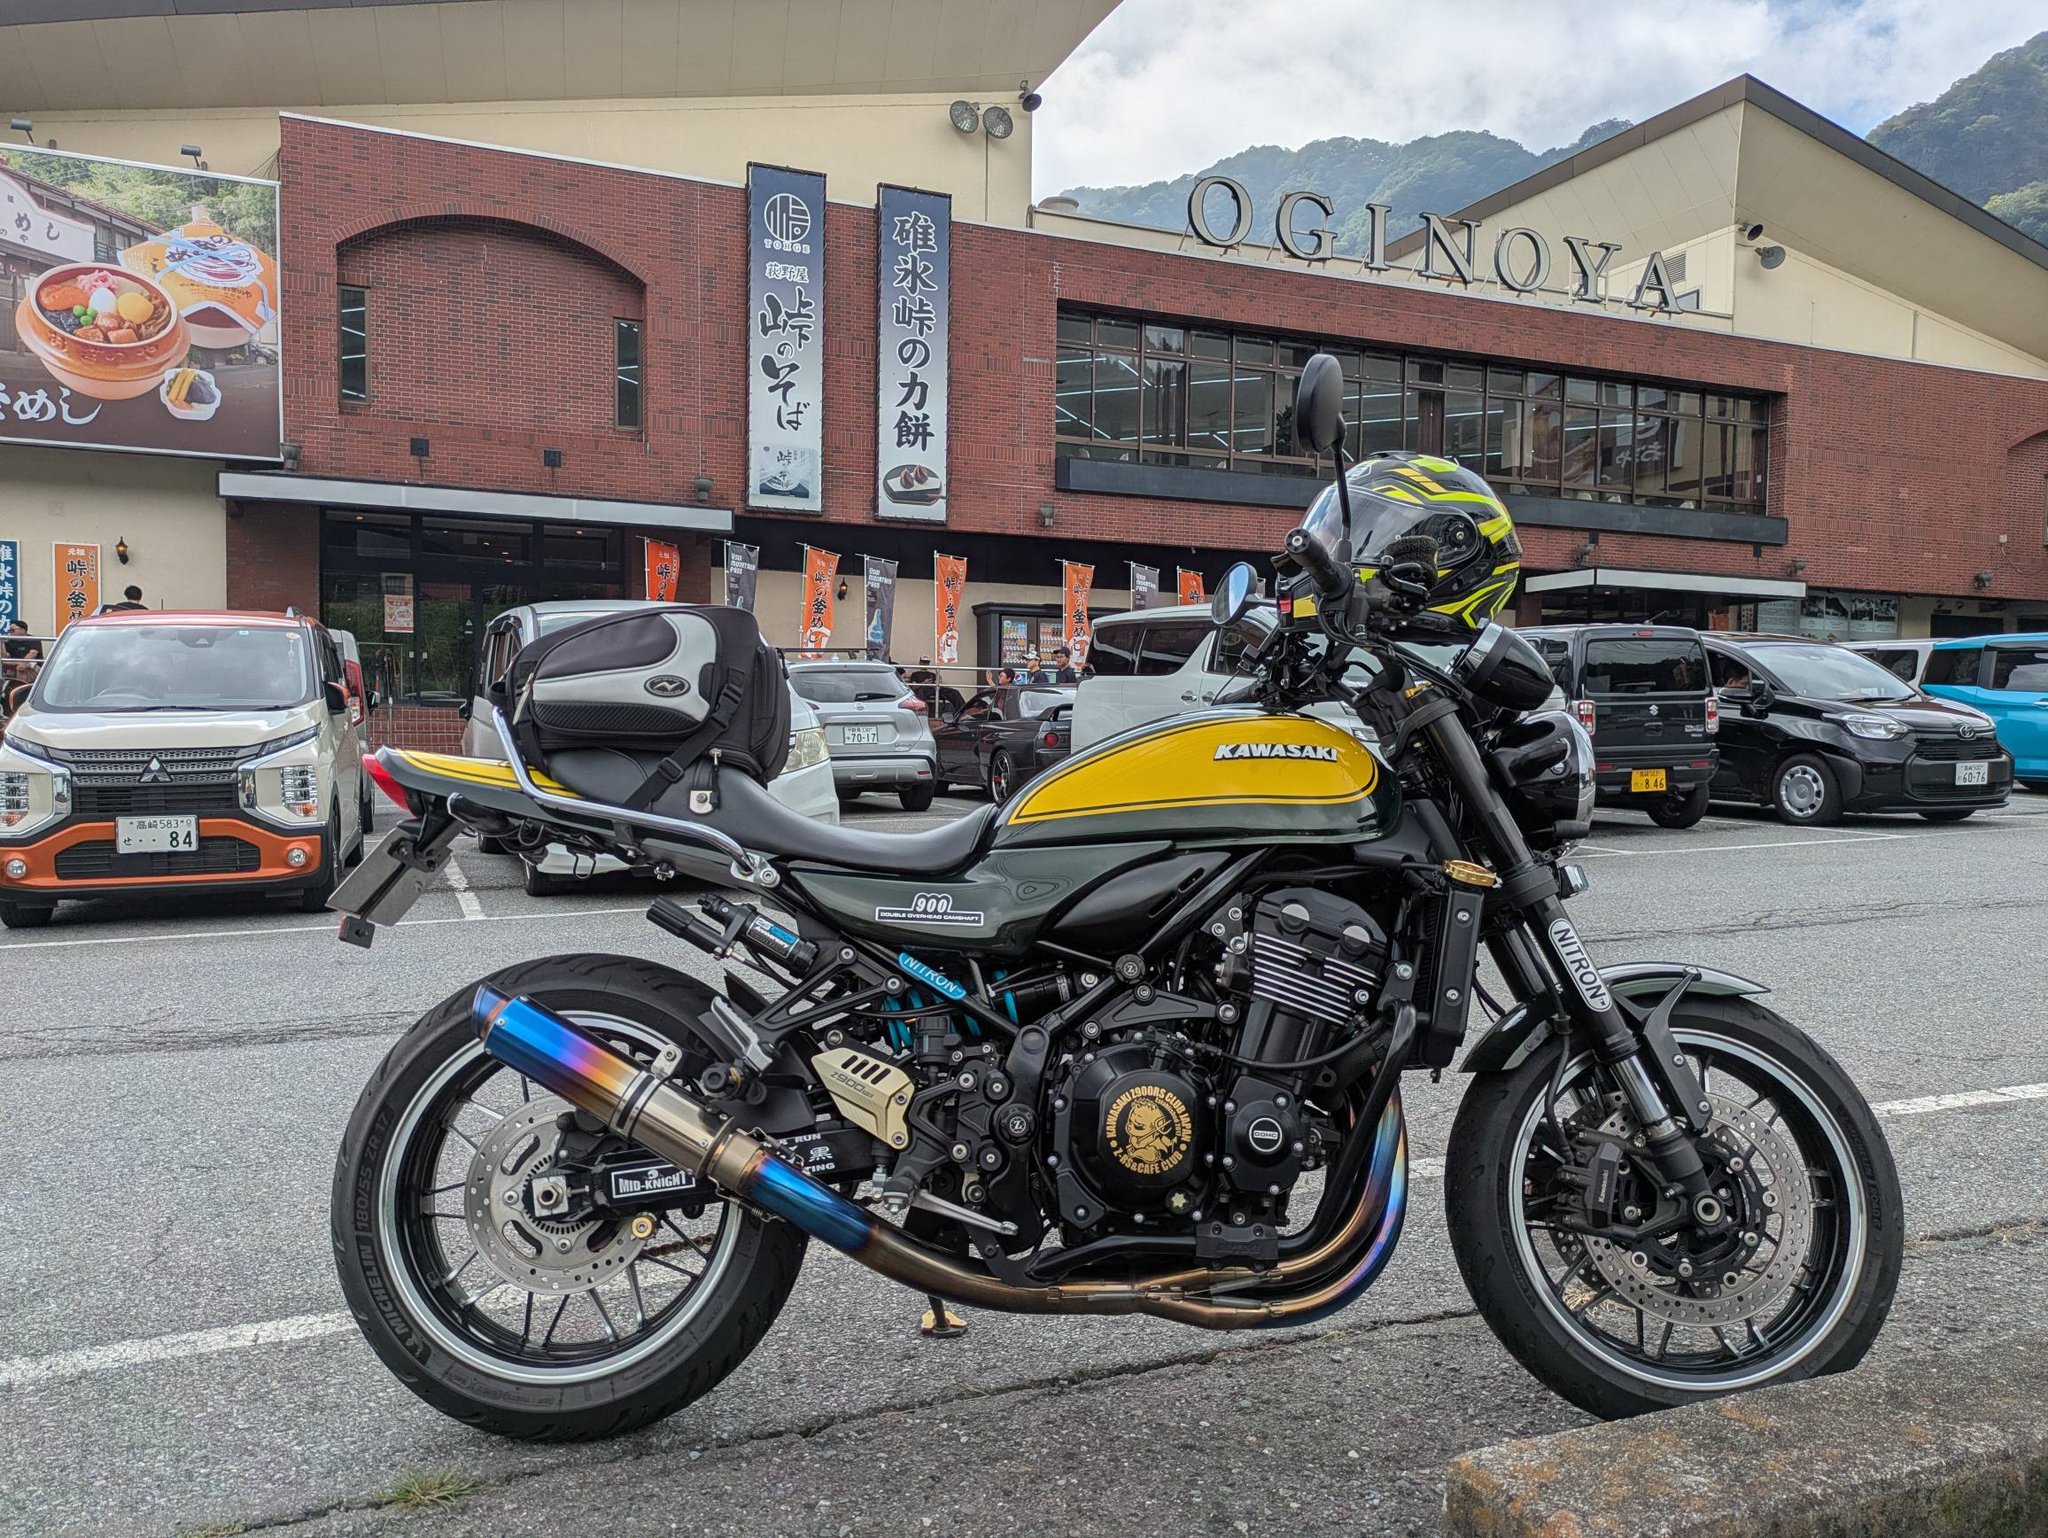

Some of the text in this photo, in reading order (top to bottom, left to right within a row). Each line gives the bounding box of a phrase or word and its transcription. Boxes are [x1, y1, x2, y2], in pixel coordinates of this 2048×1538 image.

[764, 238, 811, 254] TOHGE
[1187, 175, 1684, 315] OGINOYA
[765, 261, 810, 284] 荻野屋
[893, 211, 938, 452] 碓氷峠の力餅
[758, 286, 816, 432] 峠のそば
[0, 382, 103, 425] めし
[1213, 743, 1338, 763] KAWASAKI
[169, 830, 193, 848] 84
[907, 912, 942, 920] OVERHEAD
[916, 898, 948, 913] 900
[904, 957, 957, 993] NITRON
[1553, 928, 1606, 1000] NITRON
[1106, 1085, 1192, 1142] KAWASAKI Z900RS CLUB JAPAN
[1160, 1150, 1184, 1172] CLUB
[355, 1165, 373, 1230] 180/55
[364, 1137, 381, 1160] ZR
[618, 1171, 687, 1194] MID-KNIGHT
[359, 1244, 410, 1335] MICHELIN
